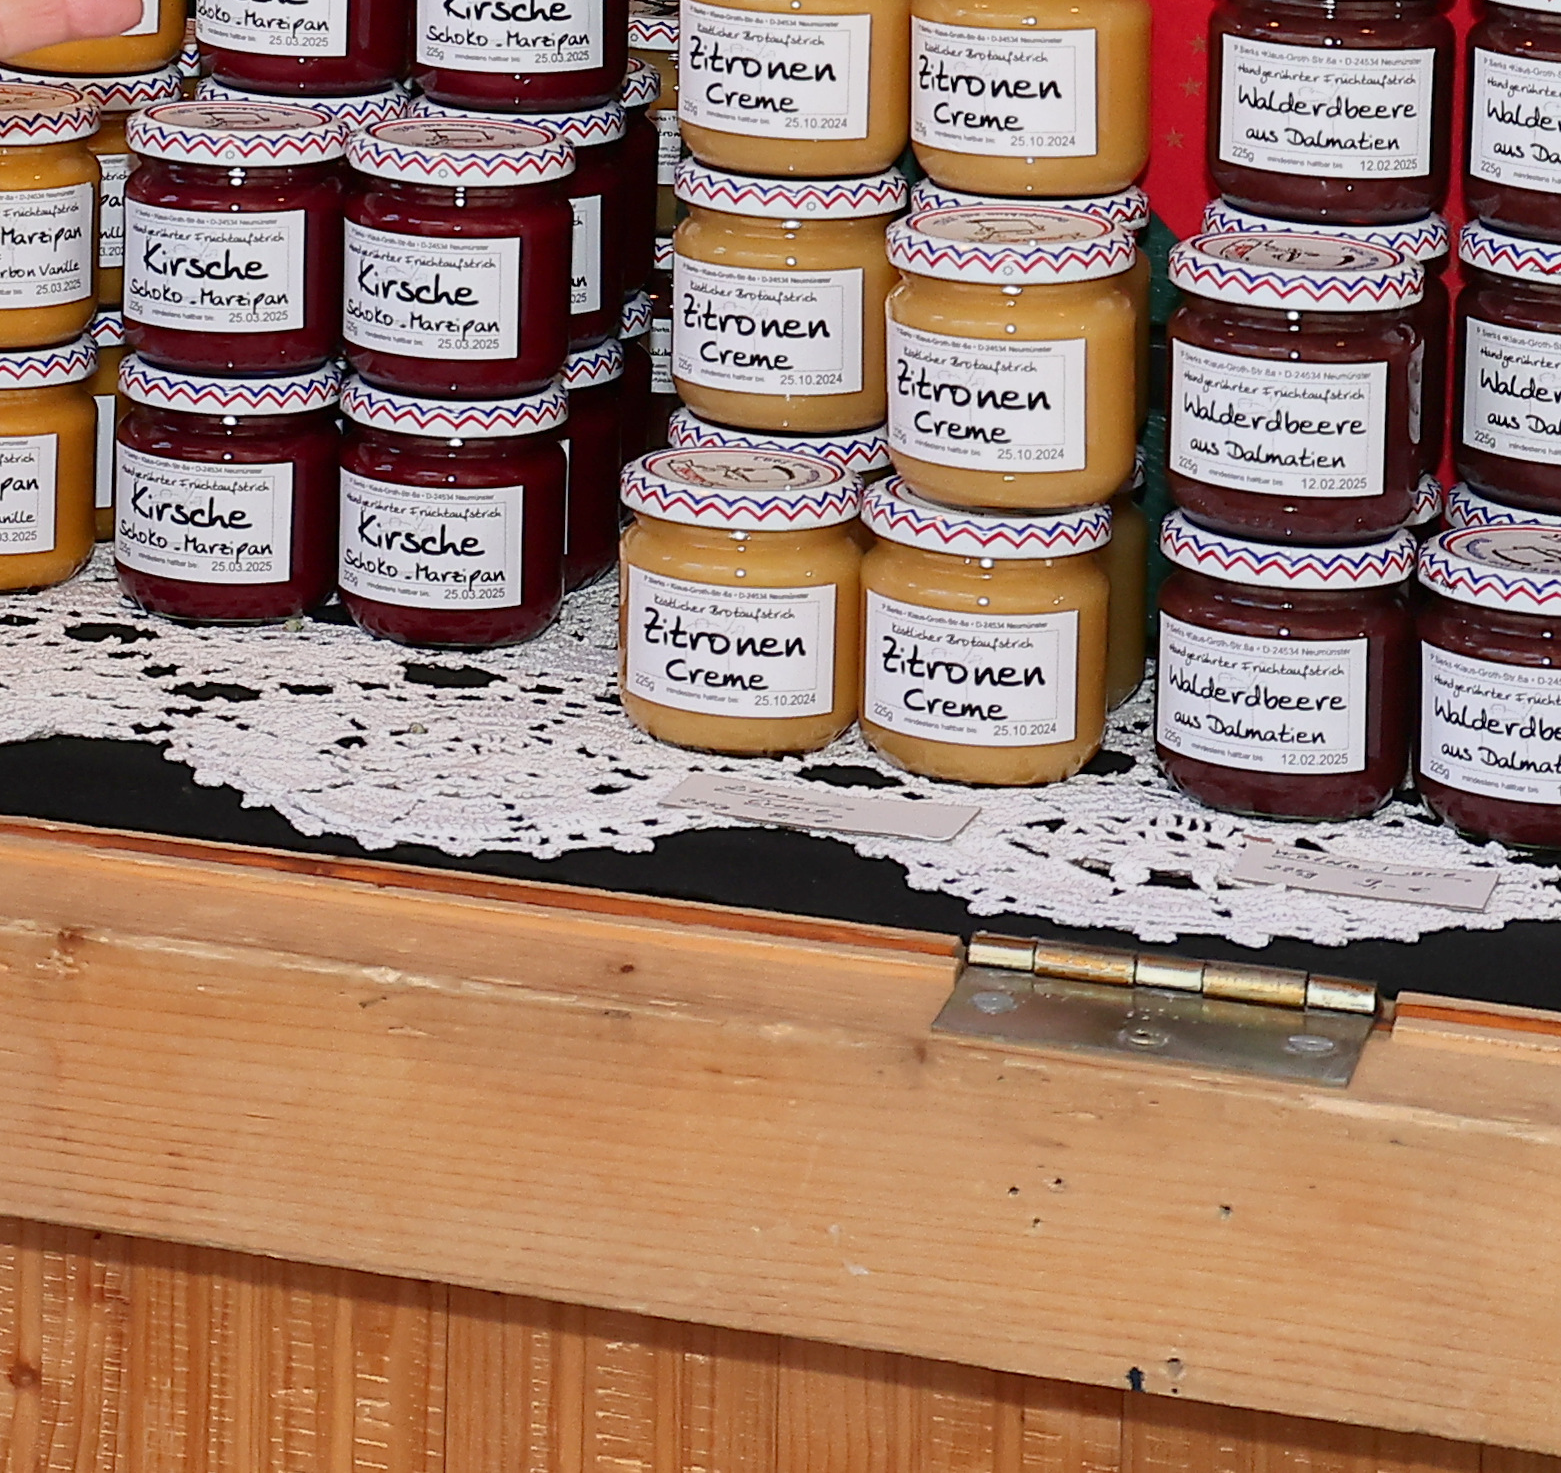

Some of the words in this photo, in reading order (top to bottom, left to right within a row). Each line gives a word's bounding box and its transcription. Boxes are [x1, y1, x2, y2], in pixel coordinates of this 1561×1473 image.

[690, 35, 837, 83] Zitronen
[919, 54, 1063, 101] Zitronen
[705, 82, 801, 115] Creme
[933, 102, 1025, 132] Creme
[1238, 85, 1417, 119] Walderdbeere
[1246, 127, 1279, 143] aus
[1284, 127, 1400, 151] Dalmatien
[1360, 159, 1417, 172] 12.02.2025
[143, 240, 269, 282] Kirsche
[357, 263, 480, 308] Kirsche
[897, 359, 1052, 412] Zitronen
[913, 411, 1012, 445] Creme
[131, 486, 253, 531] Kirsche
[357, 512, 487, 558] Kirsche
[643, 607, 807, 658] Zitronen
[665, 659, 770, 692] Creme
[881, 636, 1046, 688] Zitronen
[903, 689, 1009, 721] Creme
[1168, 665, 1348, 712] Walderdbeere
